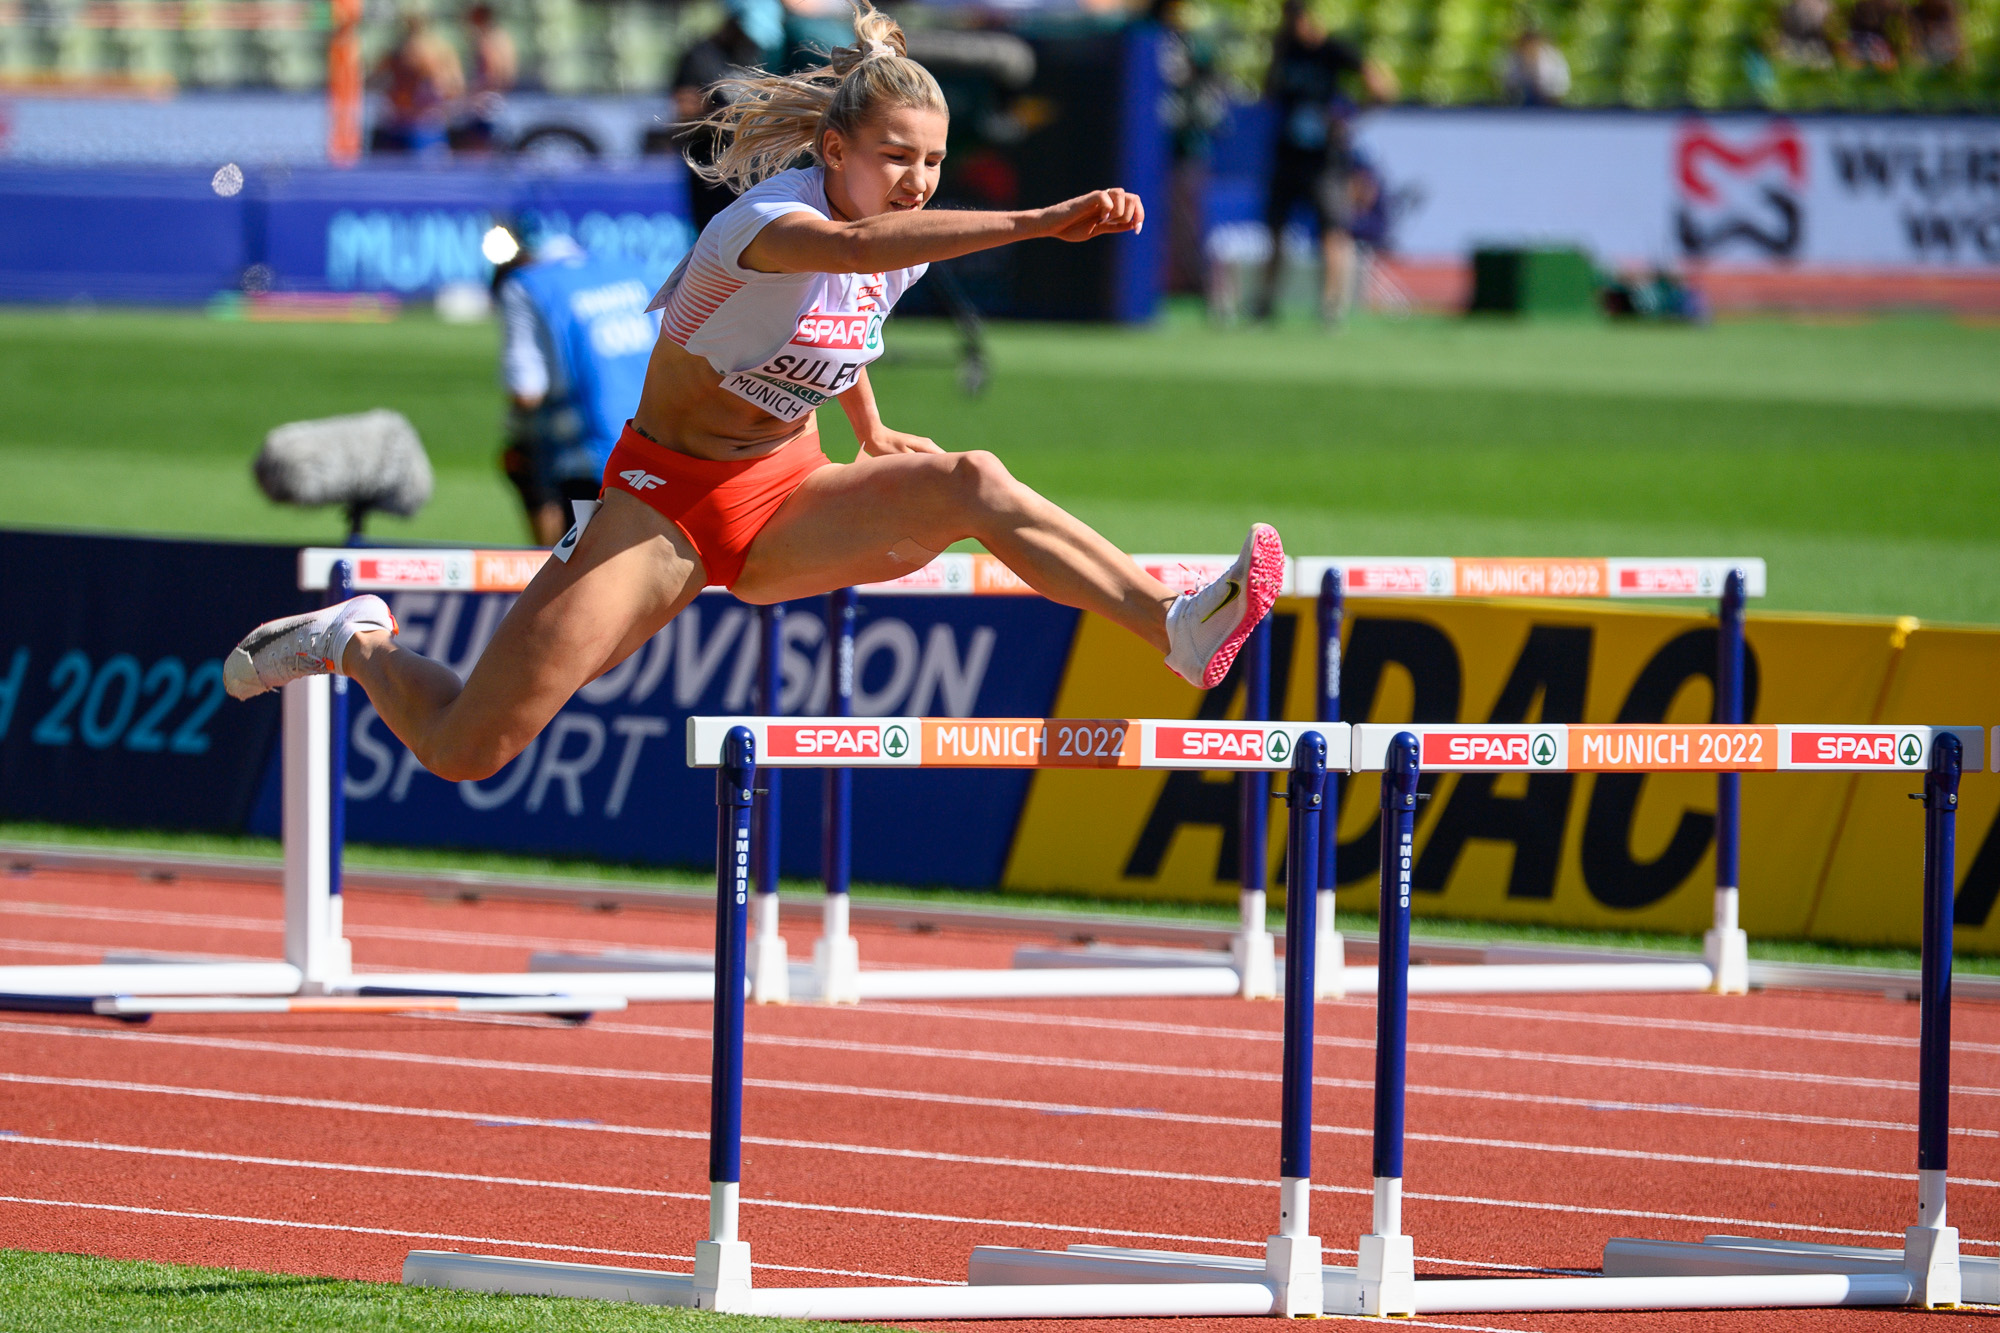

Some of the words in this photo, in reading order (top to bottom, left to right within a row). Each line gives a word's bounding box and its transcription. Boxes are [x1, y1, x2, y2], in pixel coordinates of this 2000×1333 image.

[796, 319, 866, 345] SPAR
[730, 375, 803, 419] MUNICH
[799, 388, 830, 406] CLEA
[619, 469, 667, 491] 4F
[1463, 564, 1545, 595] MUNICH
[1548, 564, 1601, 595] 2022
[392, 592, 998, 718] EUVISION
[32, 648, 227, 754] 2022
[345, 705, 668, 818] SRT
[794, 730, 879, 754] SPAR
[937, 726, 1048, 757] MUNICH
[1058, 726, 1126, 757] 2022
[1182, 731, 1262, 756] SPAR
[1121, 612, 1760, 910] ADAC
[1449, 737, 1528, 761] SPAR
[1582, 733, 1690, 764] MUNICH
[1698, 733, 1764, 763] 2022
[1816, 736, 1895, 760] SPAR
[736, 840, 749, 905] MONDO
[1400, 845, 1412, 908] MONDO
